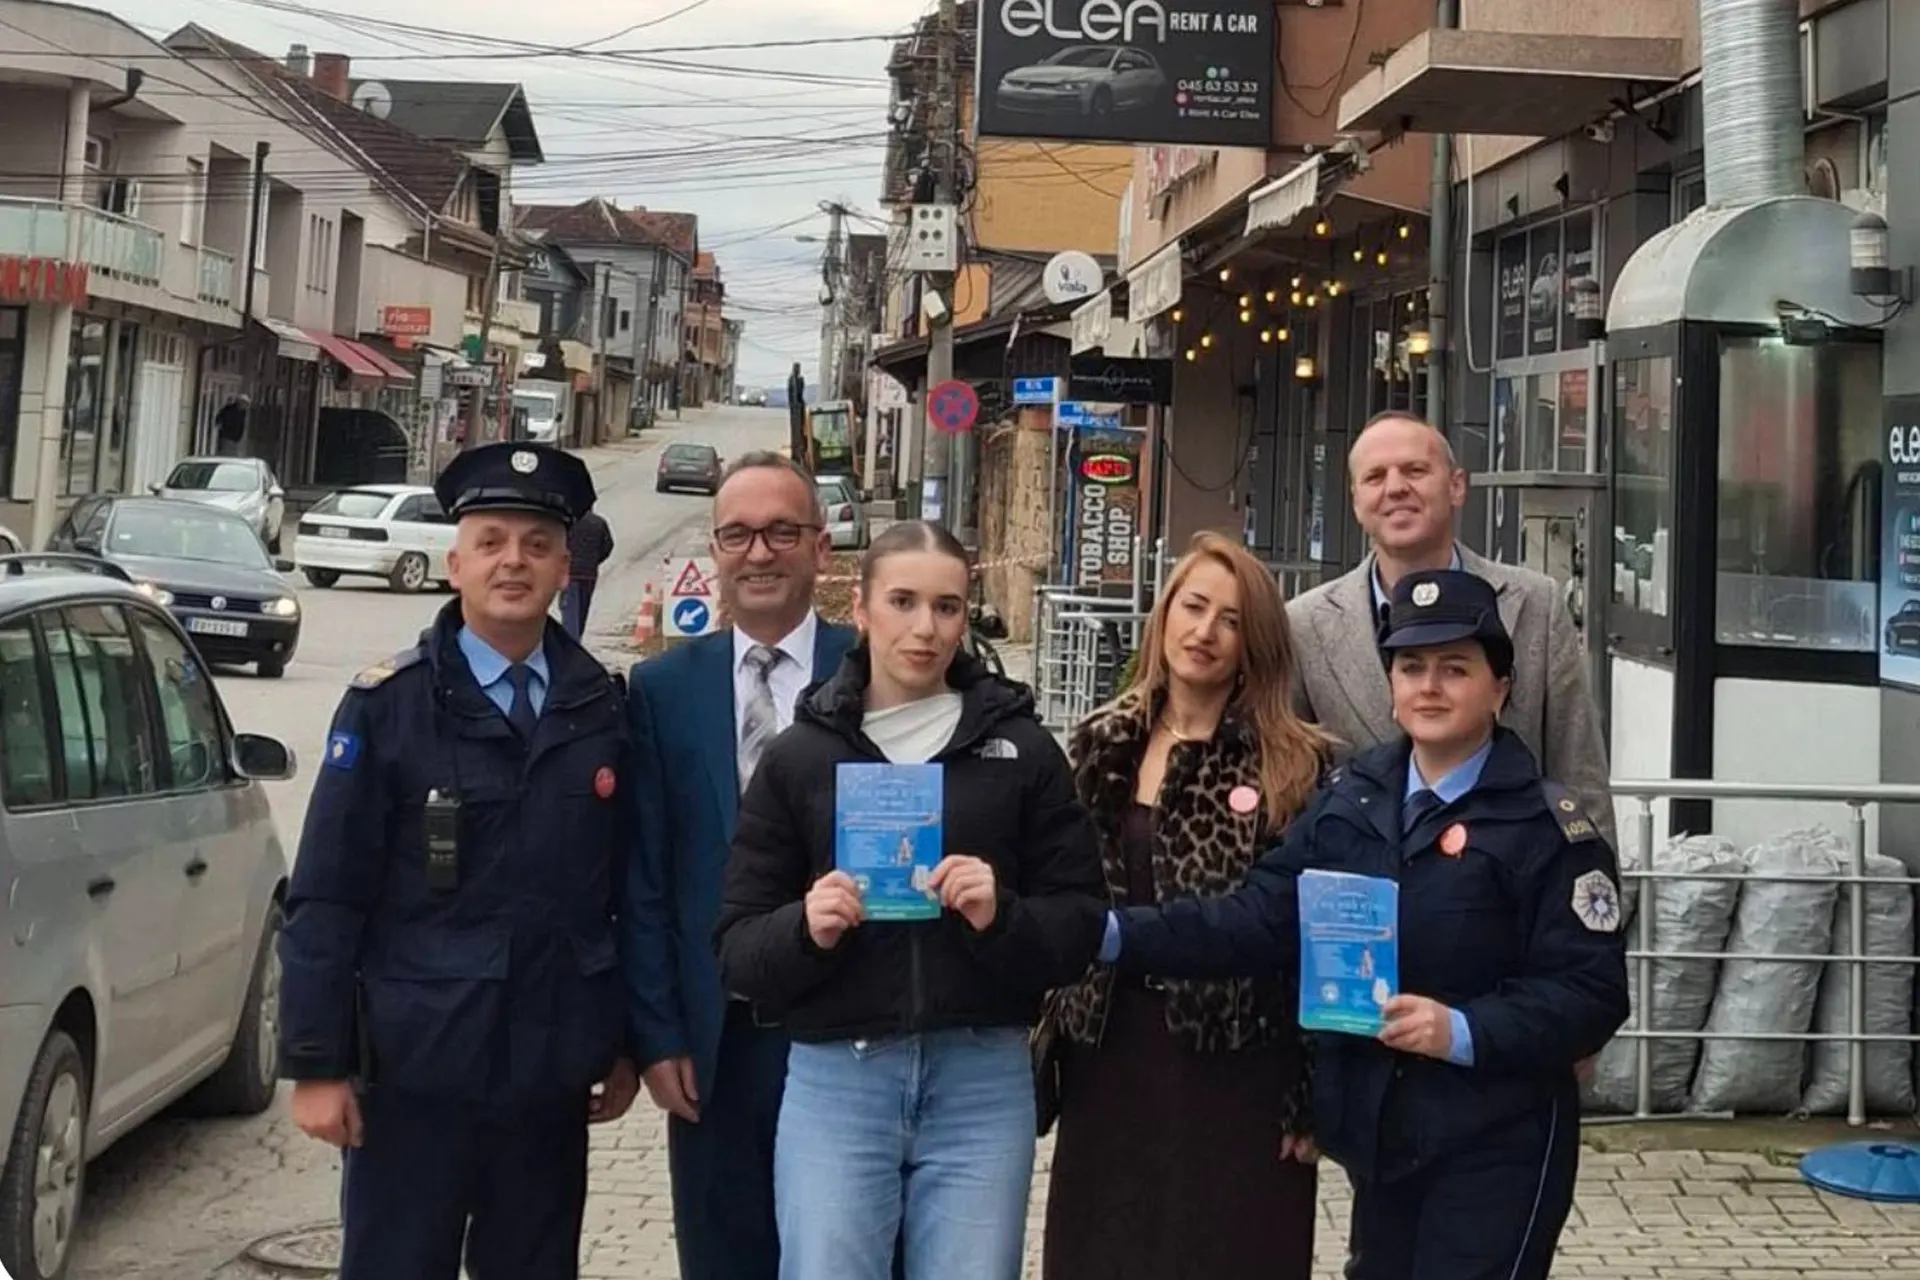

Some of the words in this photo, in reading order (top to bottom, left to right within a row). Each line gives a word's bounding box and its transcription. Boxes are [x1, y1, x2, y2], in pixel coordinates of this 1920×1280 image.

[1169, 12, 1208, 31] RENT
[1212, 14, 1223, 32] A
[1227, 14, 1258, 33] CAR
[1079, 484, 1106, 587] TOBACCO
[1107, 508, 1133, 565] SHOP
